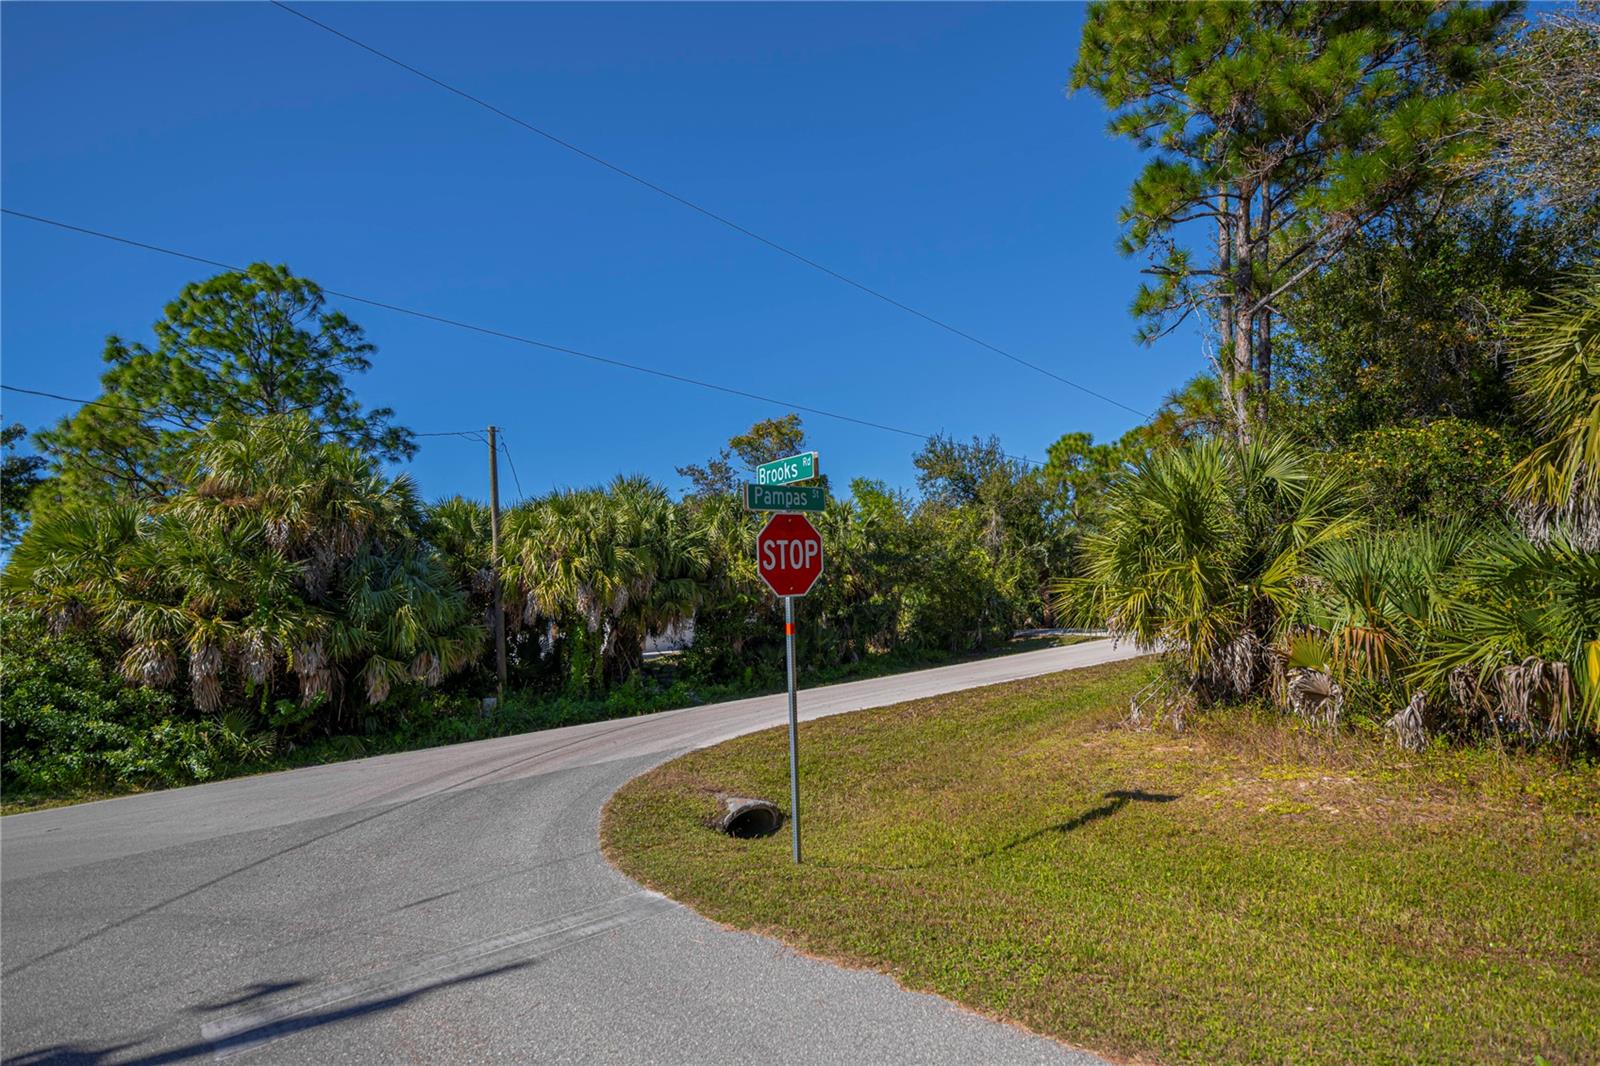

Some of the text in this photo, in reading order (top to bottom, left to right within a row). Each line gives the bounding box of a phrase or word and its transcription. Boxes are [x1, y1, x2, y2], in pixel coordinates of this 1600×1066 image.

[760, 456, 811, 485] Brooks Rd
[754, 486, 820, 508] Pampas St
[763, 539, 818, 570] STOP
